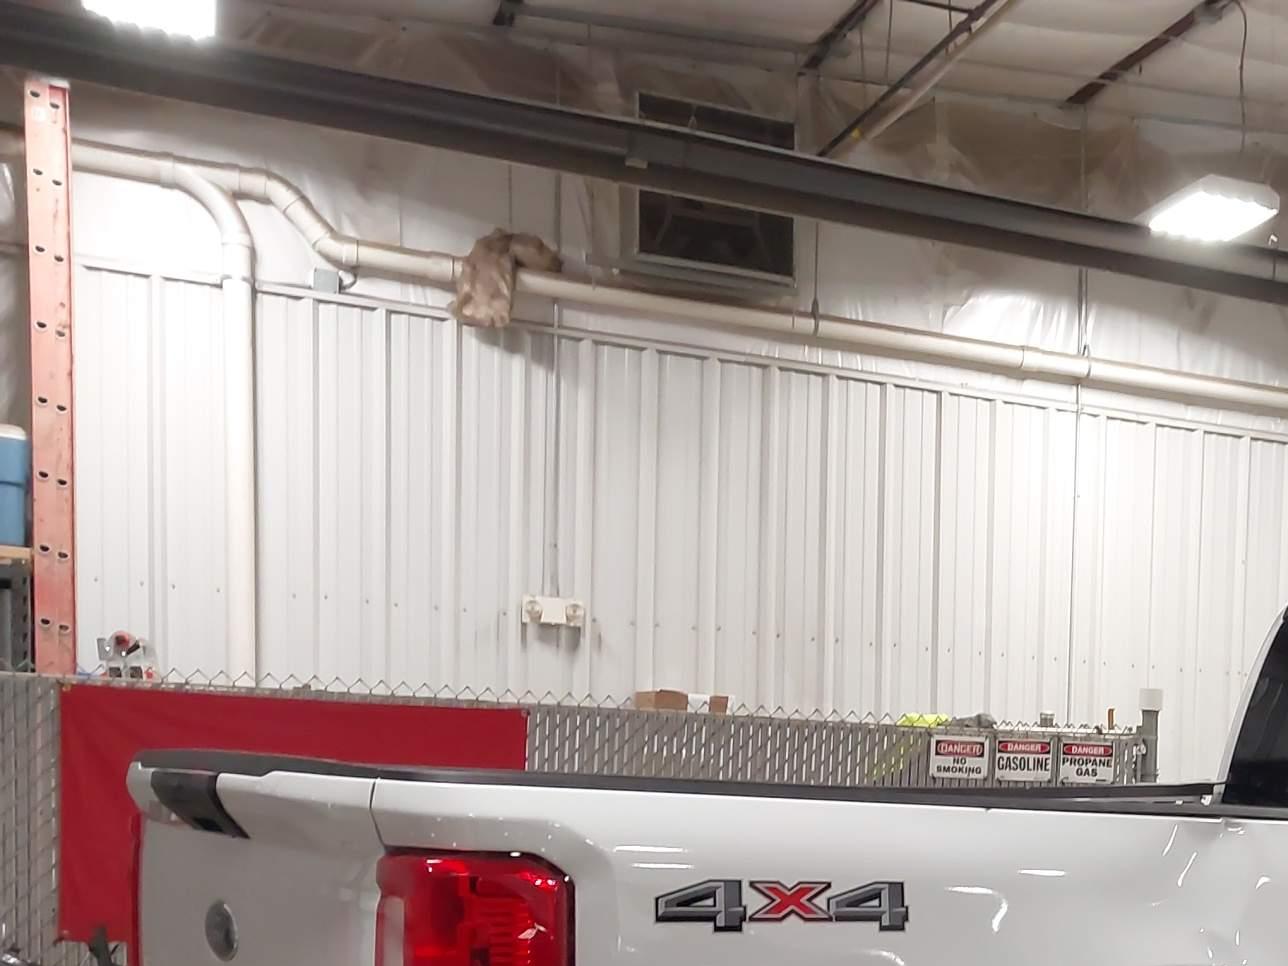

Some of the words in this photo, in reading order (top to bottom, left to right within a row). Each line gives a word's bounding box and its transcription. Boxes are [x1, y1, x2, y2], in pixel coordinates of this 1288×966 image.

[1007, 742, 1041, 753] DANGER
[1071, 745, 1105, 756] DANGER
[952, 757, 967, 765] NO
[997, 755, 1051, 772] GASOLINE
[1062, 757, 1112, 768] PROPANE
[936, 764, 982, 775] SMOKING
[1076, 767, 1097, 777] GAS
[655, 879, 909, 932] 4X4
